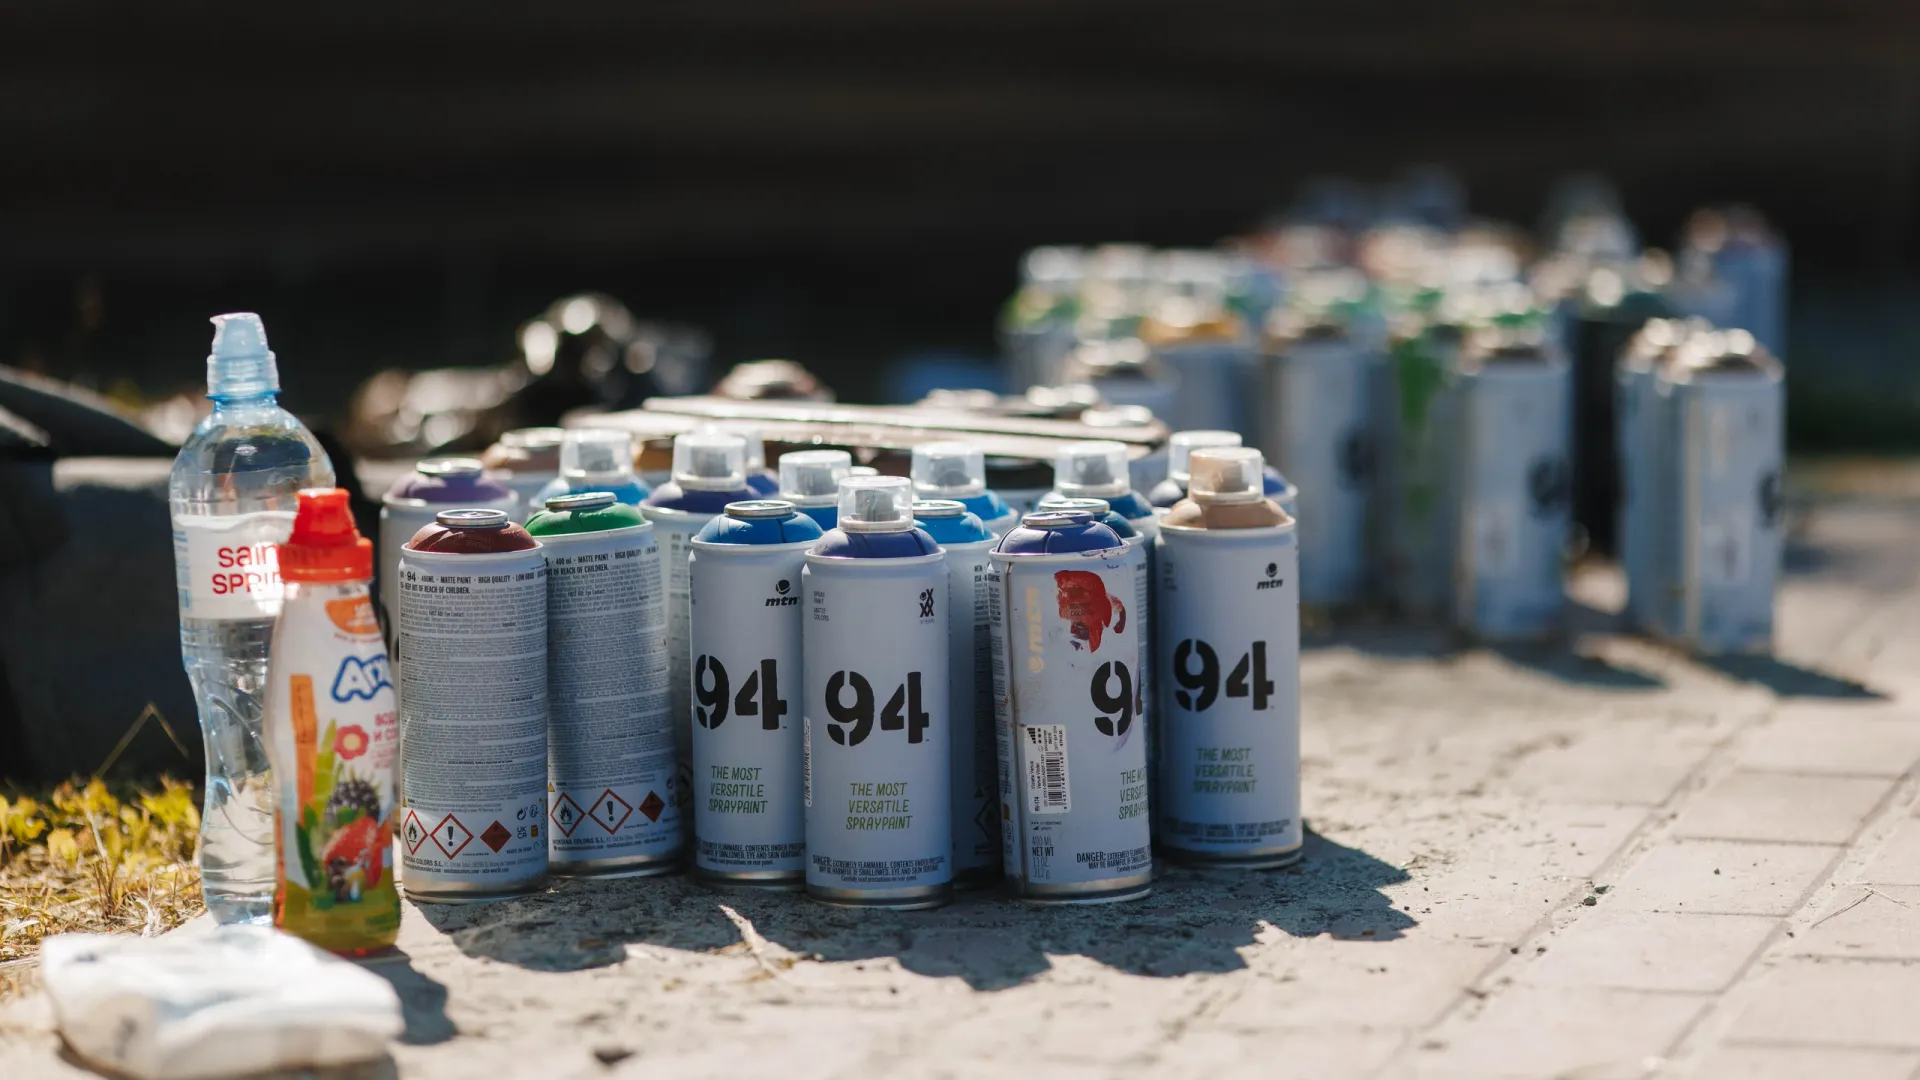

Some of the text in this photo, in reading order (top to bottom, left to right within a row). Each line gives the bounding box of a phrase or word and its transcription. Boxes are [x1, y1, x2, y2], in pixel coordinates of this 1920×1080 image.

[217, 546, 279, 568] sain
[212, 572, 281, 594] SPRI
[406, 570, 416, 582] 94
[1256, 579, 1283, 590] mtn
[765, 596, 798, 606] mtn
[1174, 638, 1274, 712] 94
[695, 654, 787, 730] 94
[1091, 660, 1143, 736] 9
[825, 670, 930, 746] 94
[1196, 748, 1252, 761] THE MOST
[711, 766, 762, 780] THE MOST
[1120, 769, 1136, 786] THE
[1195, 764, 1255, 778] VERSATILE
[710, 782, 764, 797] VERSATILE
[850, 782, 908, 796] THE MOST
[1194, 779, 1258, 794] SPRAYPAINT
[709, 798, 768, 814] SPRAYPAINT
[849, 799, 910, 813] VERSATILE
[846, 815, 913, 830] SPRAYPAINT
[1032, 847, 1054, 857] NET WT
[1076, 852, 1106, 863] DANGER:
[890, 860, 914, 868] CONTENTS
